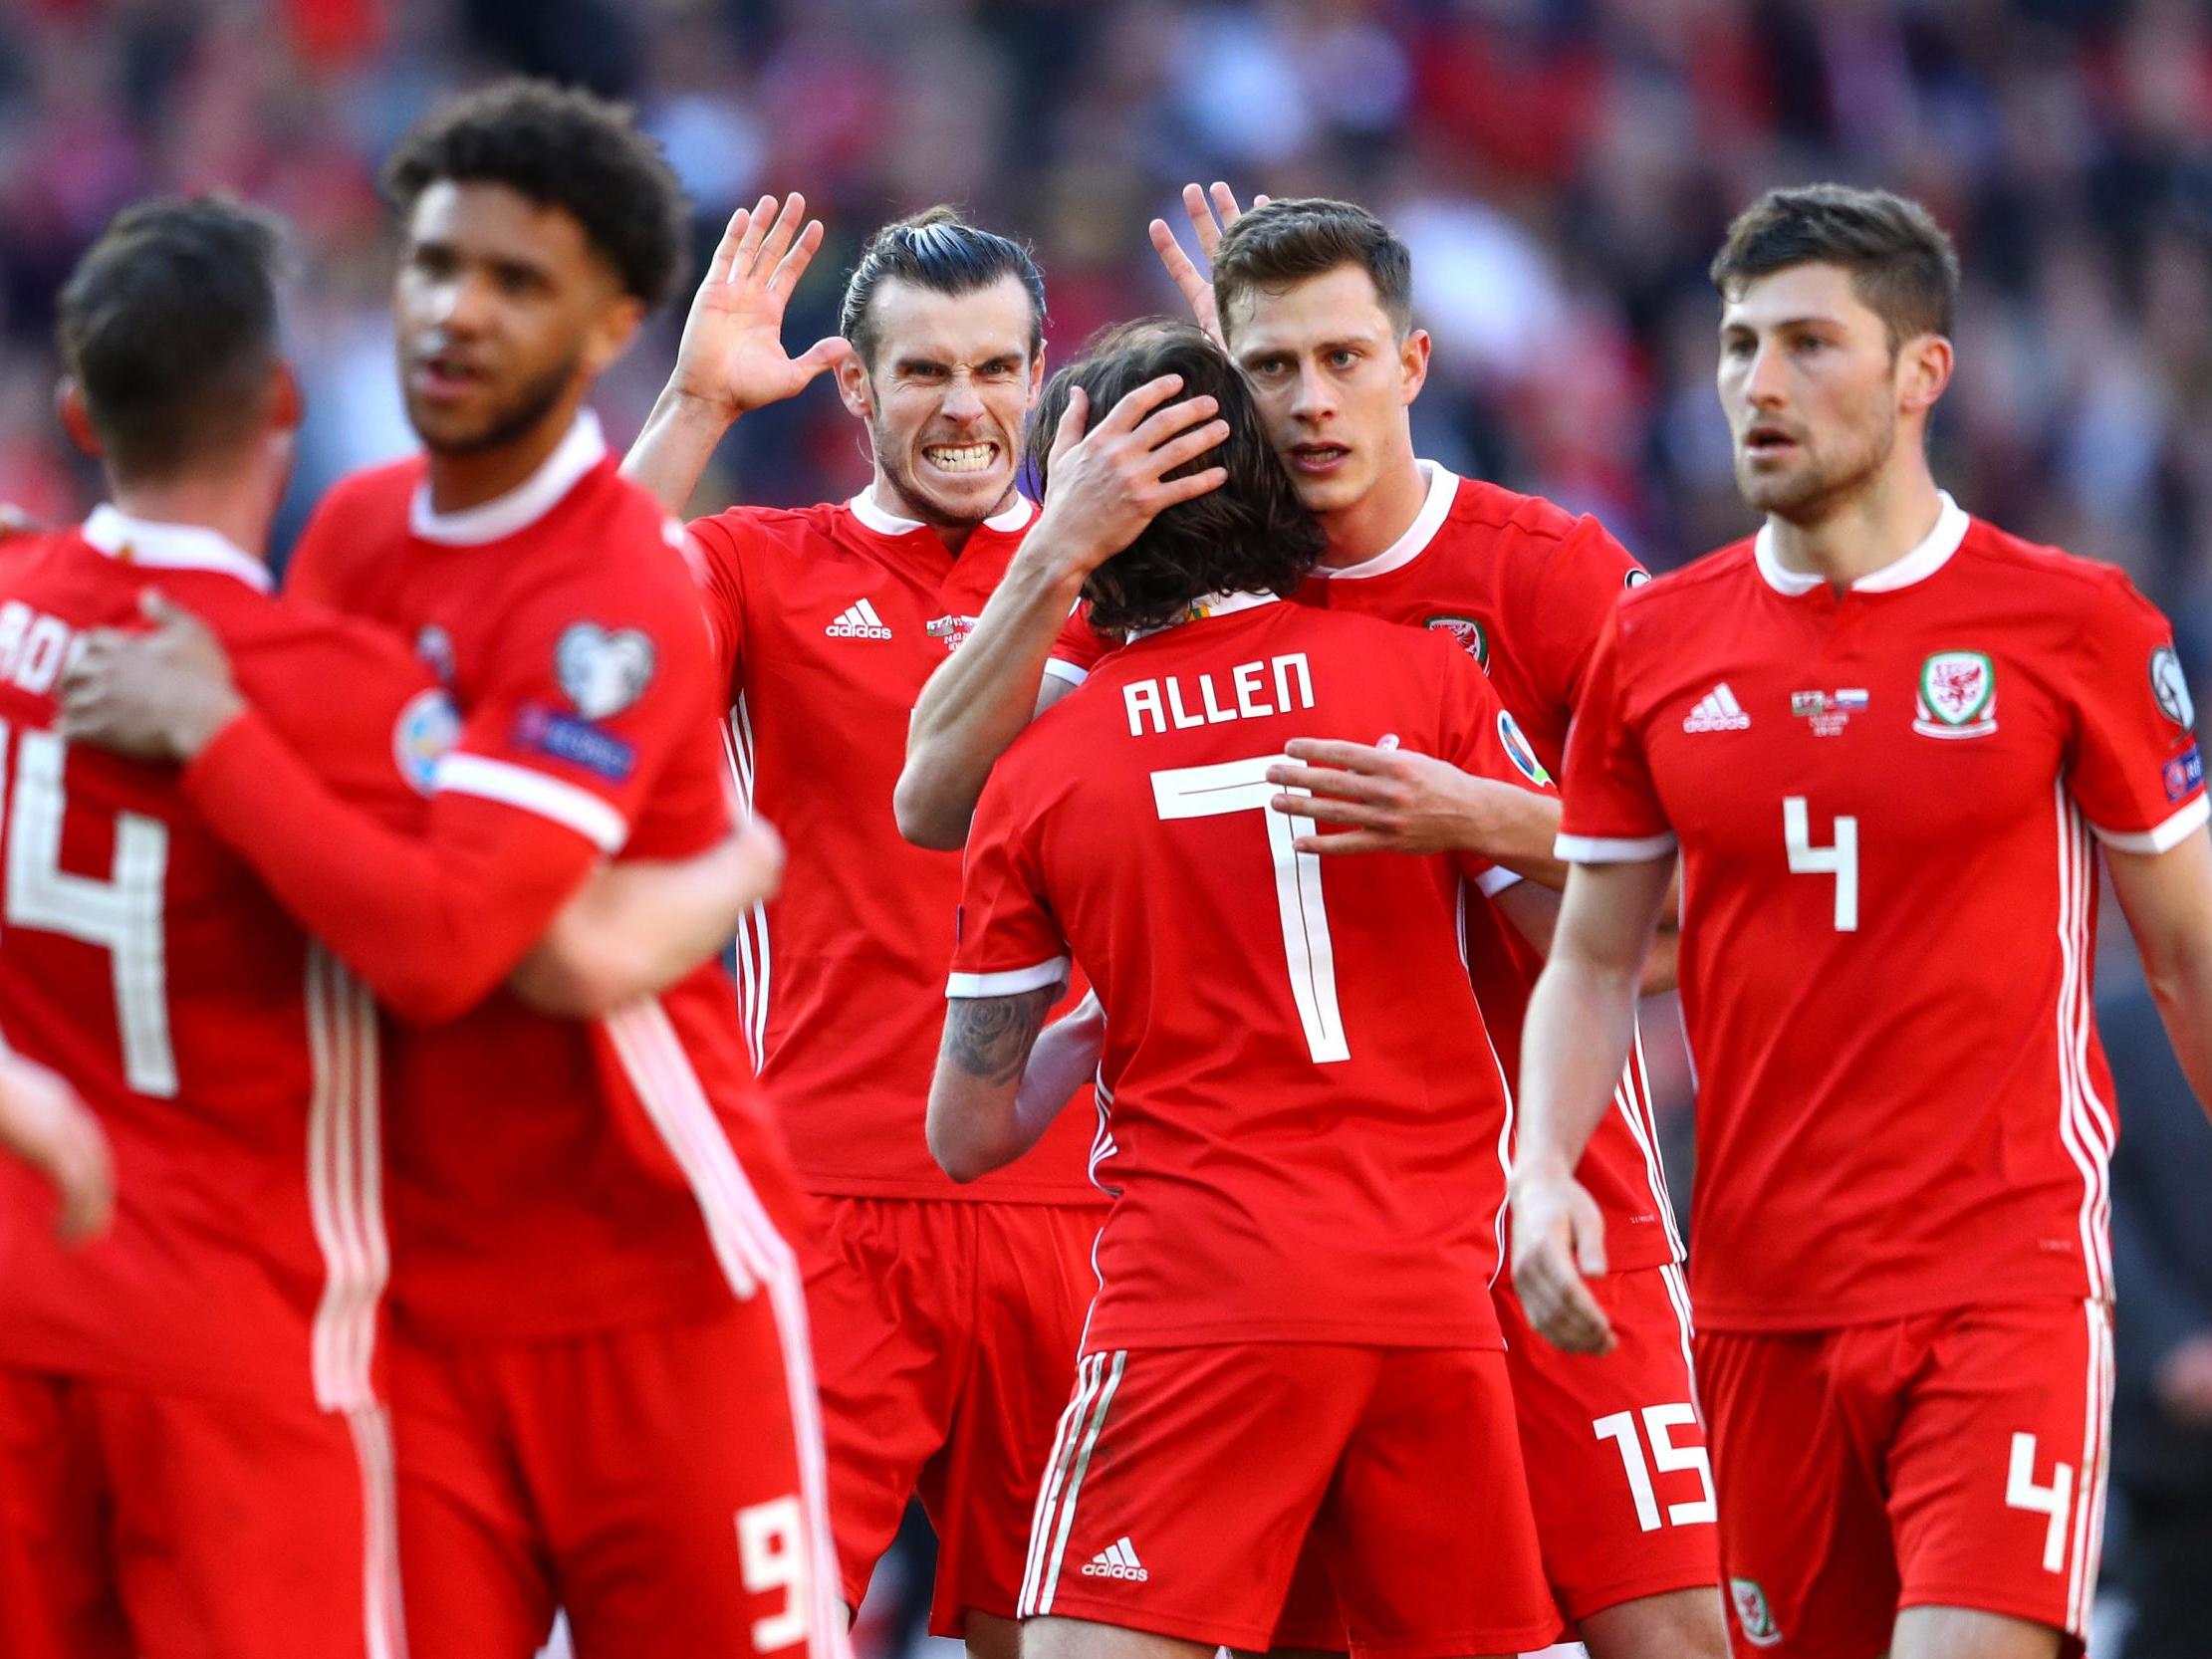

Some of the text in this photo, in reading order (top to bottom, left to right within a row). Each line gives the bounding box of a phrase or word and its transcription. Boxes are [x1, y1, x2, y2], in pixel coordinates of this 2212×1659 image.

[825, 623, 892, 639] adidas
[1122, 652, 1315, 737] ALLEN
[1683, 712, 1751, 734] adidas
[0, 719, 179, 1098] 4
[1149, 753, 1352, 1065] 7
[1783, 796, 1858, 931] 4
[1593, 1403, 1718, 1533] 15
[2005, 1431, 2074, 1574] 4
[735, 1494, 809, 1654] 9
[1081, 1563, 1148, 1582] adidas
